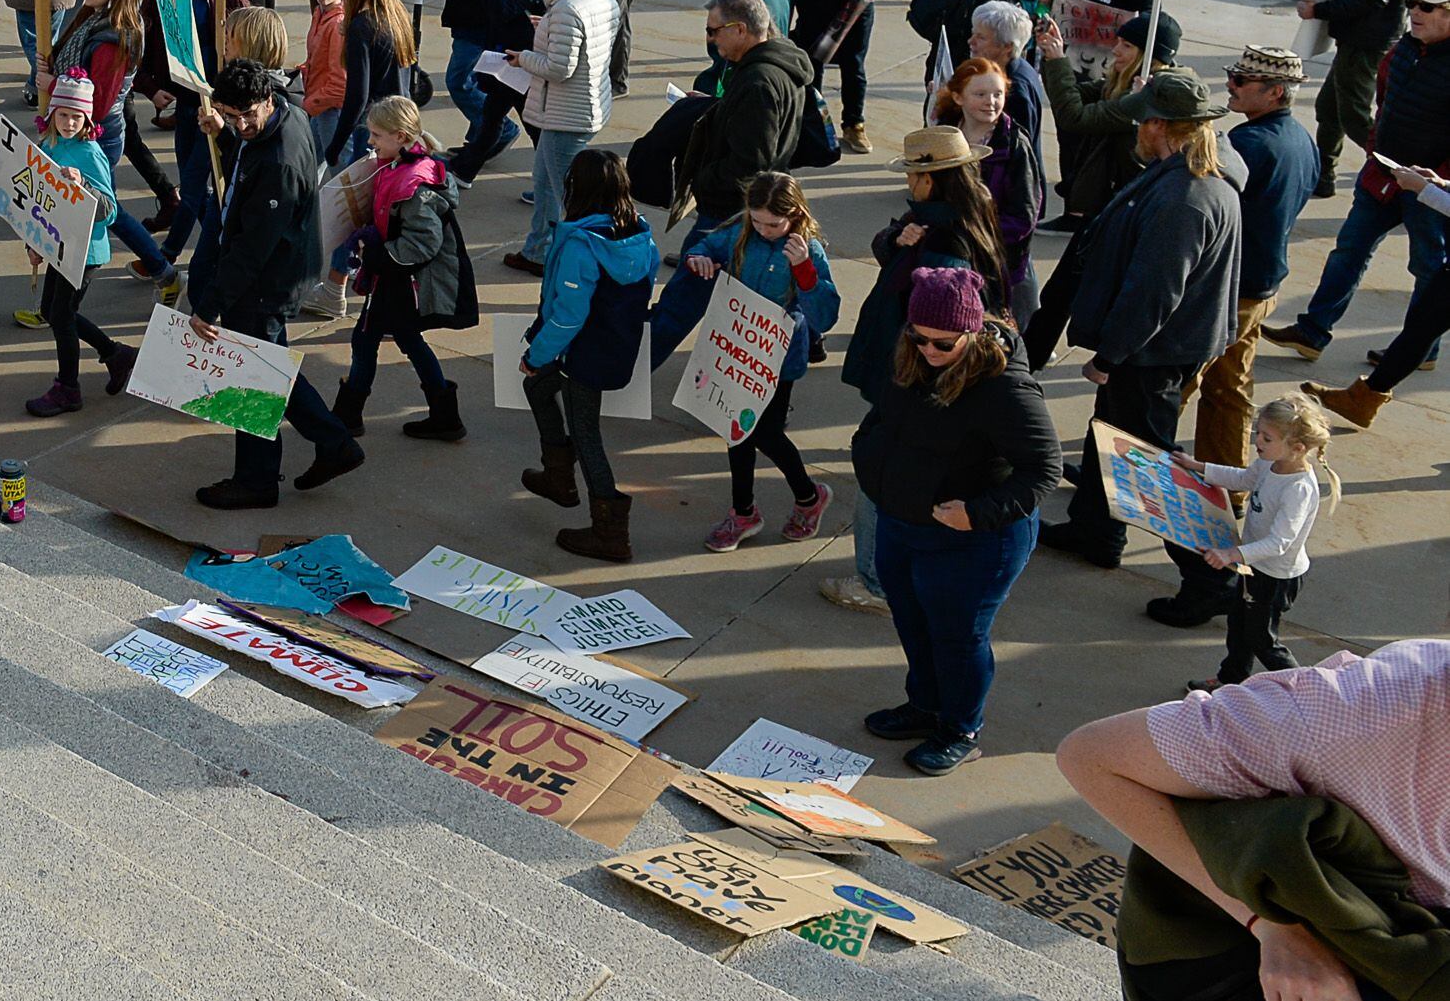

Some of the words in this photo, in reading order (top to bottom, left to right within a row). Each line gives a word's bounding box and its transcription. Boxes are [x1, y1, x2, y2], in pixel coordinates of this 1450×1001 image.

[1, 117, 18, 153] I
[27, 144, 84, 205] Want
[11, 167, 56, 212] Air
[13, 187, 27, 210] I
[728, 298, 791, 351] CLIMATE
[732, 319, 774, 357] NOW,
[186, 354, 225, 378] 2075
[710, 329, 778, 388] HOMEWORK
[715, 357, 767, 401] LATER!
[708, 381, 734, 420] This
[4, 481, 25, 491] WILD
[4, 489, 25, 497] UTAH
[557, 598, 627, 622] EMAND
[560, 611, 646, 636] CLIMATE
[180, 617, 369, 693] CLIMATE
[573, 622, 668, 650] JUSTICE!!
[146, 648, 195, 682] XPECT
[522, 653, 665, 715] RESPONSIBILITY
[550, 686, 629, 727] ETHICS
[416, 727, 496, 770] THE
[444, 684, 605, 773] SOIL
[505, 762, 577, 796] IN
[960, 864, 1020, 901] IF
[996, 841, 1072, 888] YOU
[607, 863, 752, 928] planet
